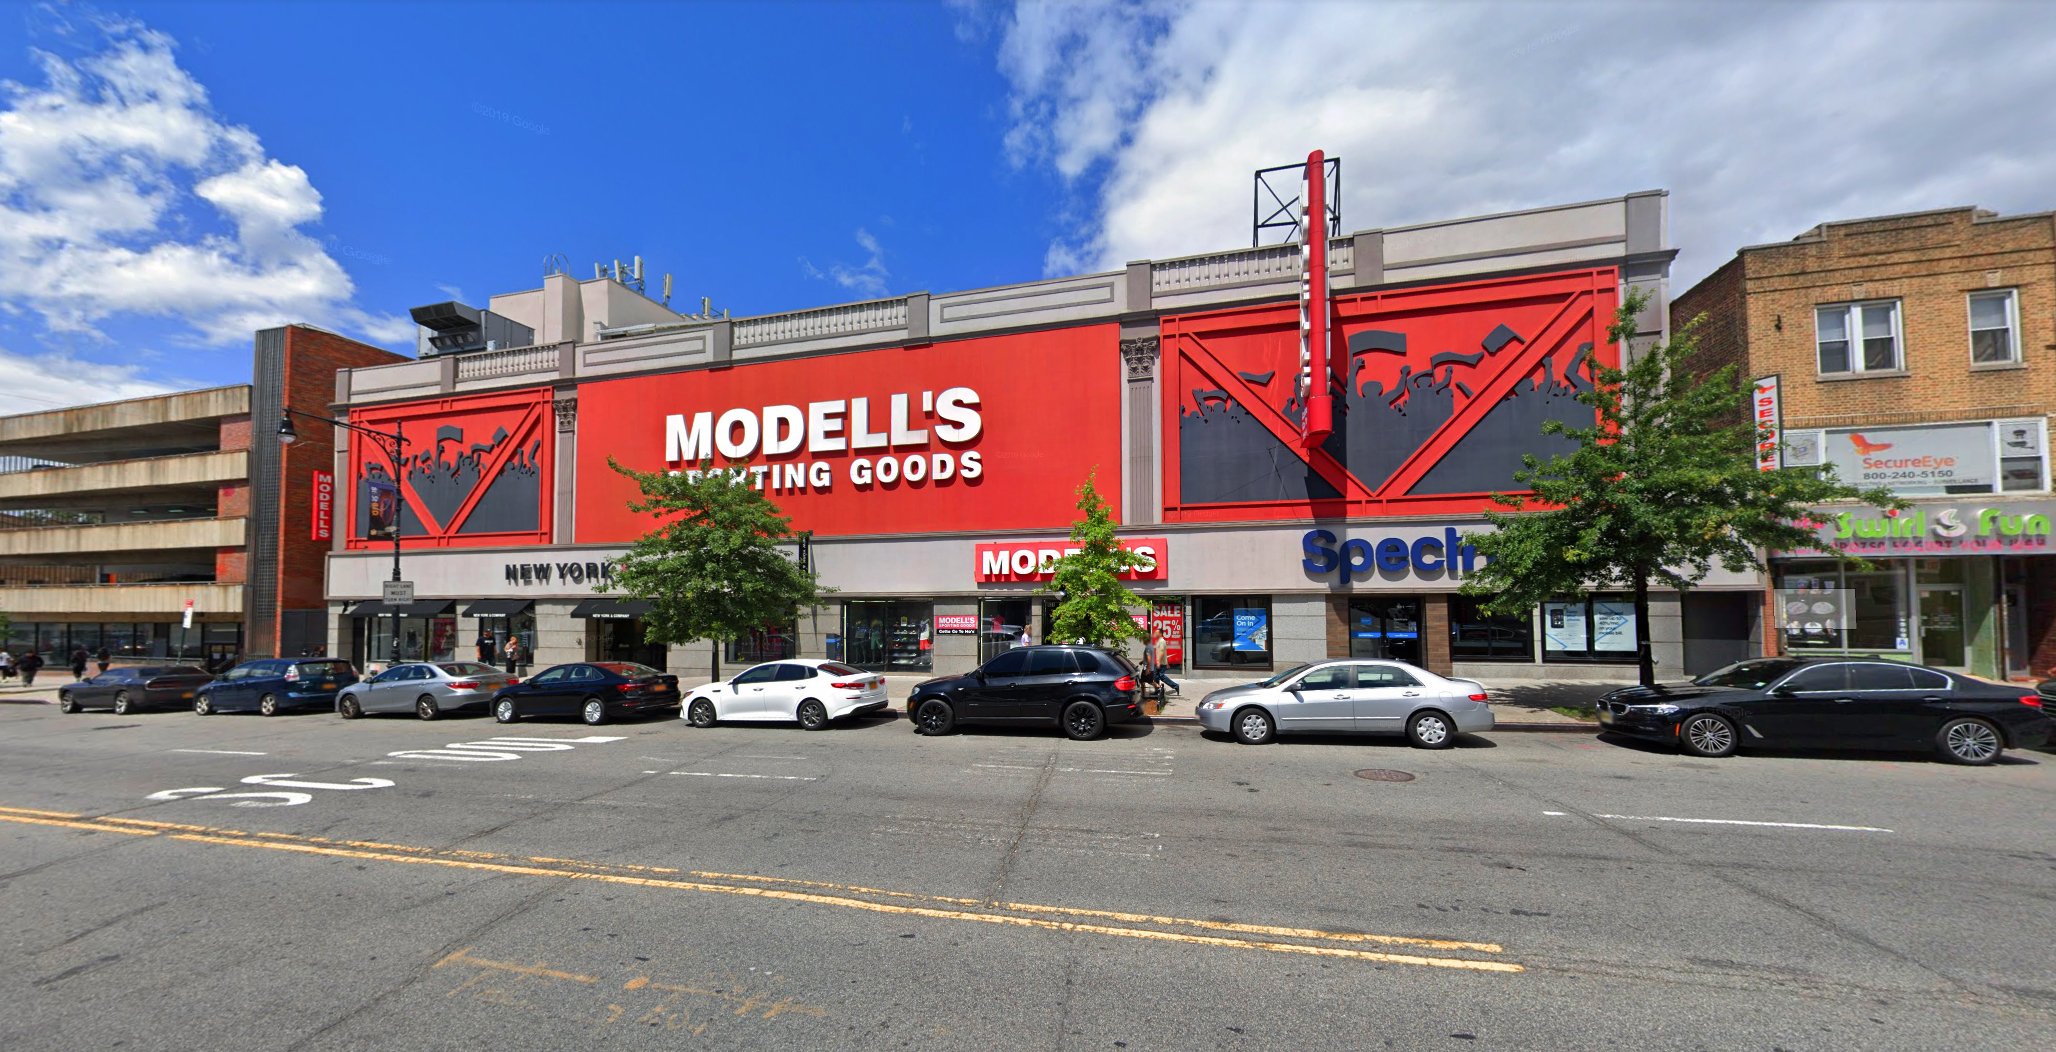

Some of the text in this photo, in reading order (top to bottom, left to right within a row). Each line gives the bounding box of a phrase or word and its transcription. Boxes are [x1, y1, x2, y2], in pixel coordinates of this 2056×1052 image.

[666, 386, 983, 462] MODELL'S
[849, 451, 983, 485] GOODS
[1862, 456, 1955, 469] SecureEye
[1863, 470, 1954, 480] 800-240-5150
[319, 474, 332, 538] MODELLS
[1835, 510, 1925, 538] Swirl
[982, 545, 1157, 576] MOD'S
[1302, 526, 1498, 585] Spectr
[505, 563, 551, 582] NEW
[555, 562, 613, 581] YORK
[1153, 605, 1181, 617] SALE
